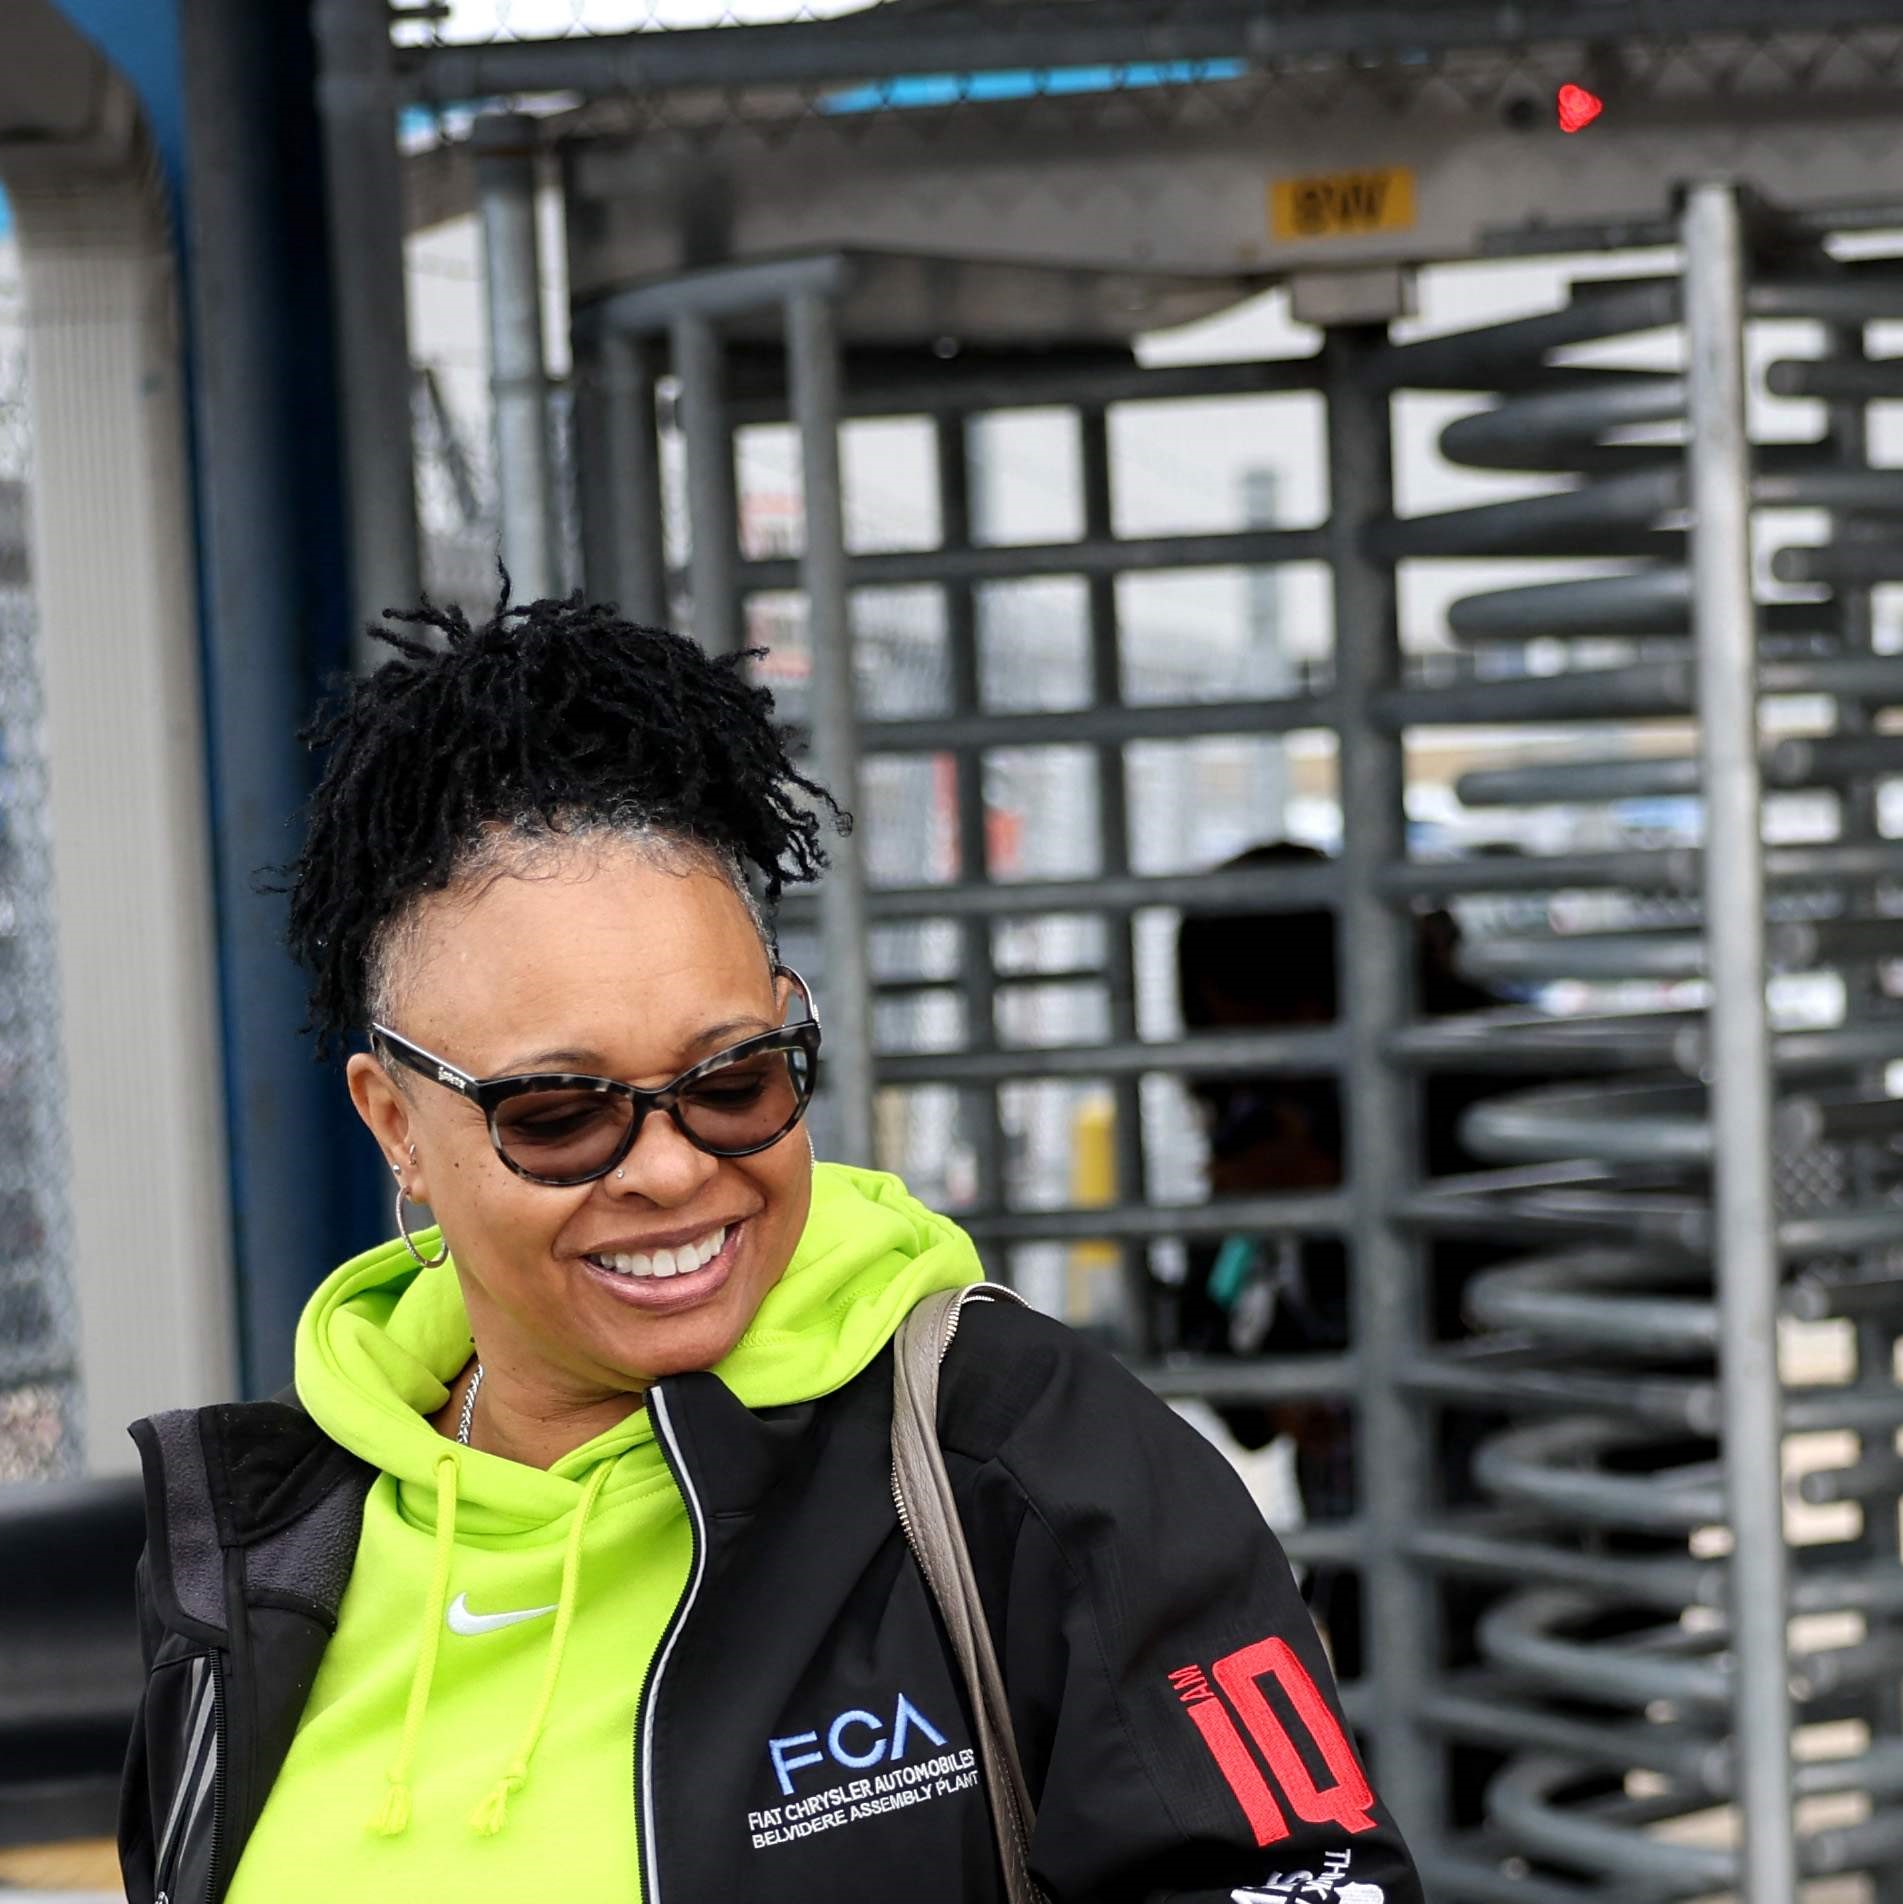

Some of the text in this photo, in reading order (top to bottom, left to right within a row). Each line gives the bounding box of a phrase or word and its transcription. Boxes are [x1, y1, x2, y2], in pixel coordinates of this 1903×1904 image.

[768, 1692, 949, 1796] FCA
[748, 1748, 976, 1831] FIAT CHRYSLER AUTOMOBILES
[752, 1769, 979, 1849] BELVIDERE ASSEMBLY PLANT
